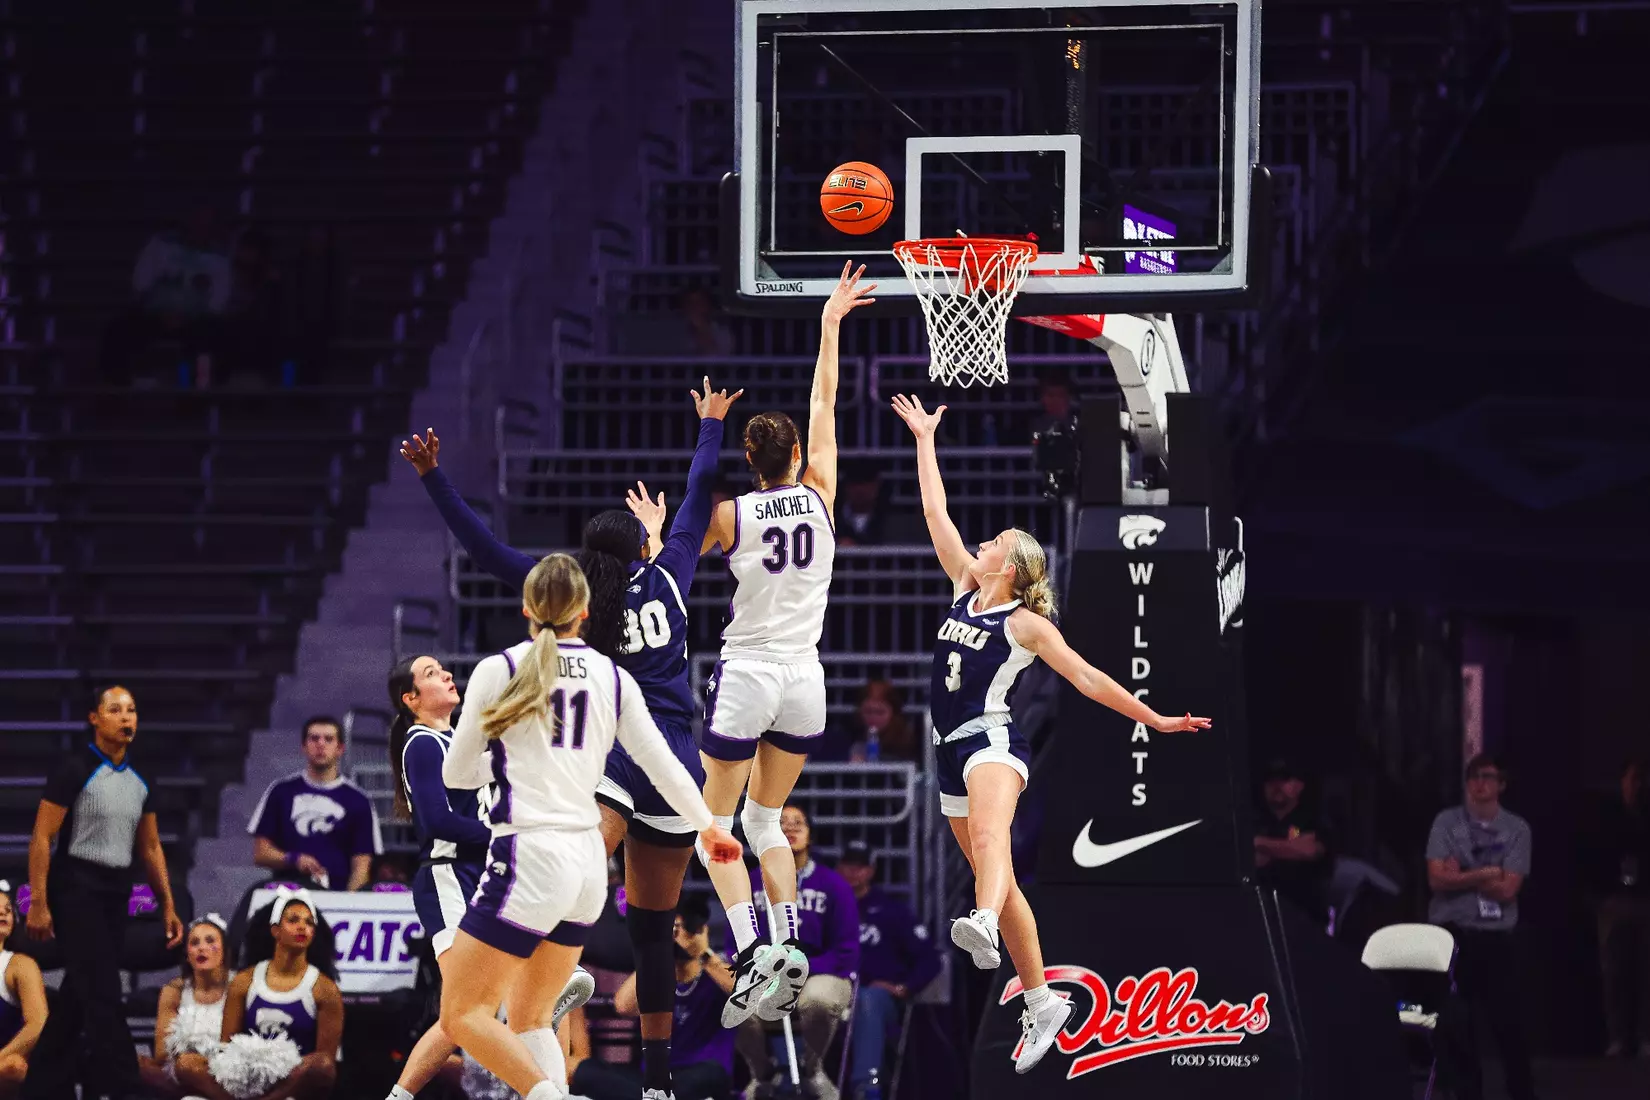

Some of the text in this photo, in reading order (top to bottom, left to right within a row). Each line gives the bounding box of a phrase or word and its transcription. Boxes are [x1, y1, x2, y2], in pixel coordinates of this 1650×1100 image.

[829, 174, 868, 190] ELITE
[755, 281, 803, 294] SPALDING
[755, 495, 814, 520] SANCHEZ
[761, 522, 815, 574] 30
[557, 655, 588, 680] DES
[944, 651, 962, 693] 3
[549, 688, 589, 750] 11
[1171, 1053, 1205, 1067] FOOD
